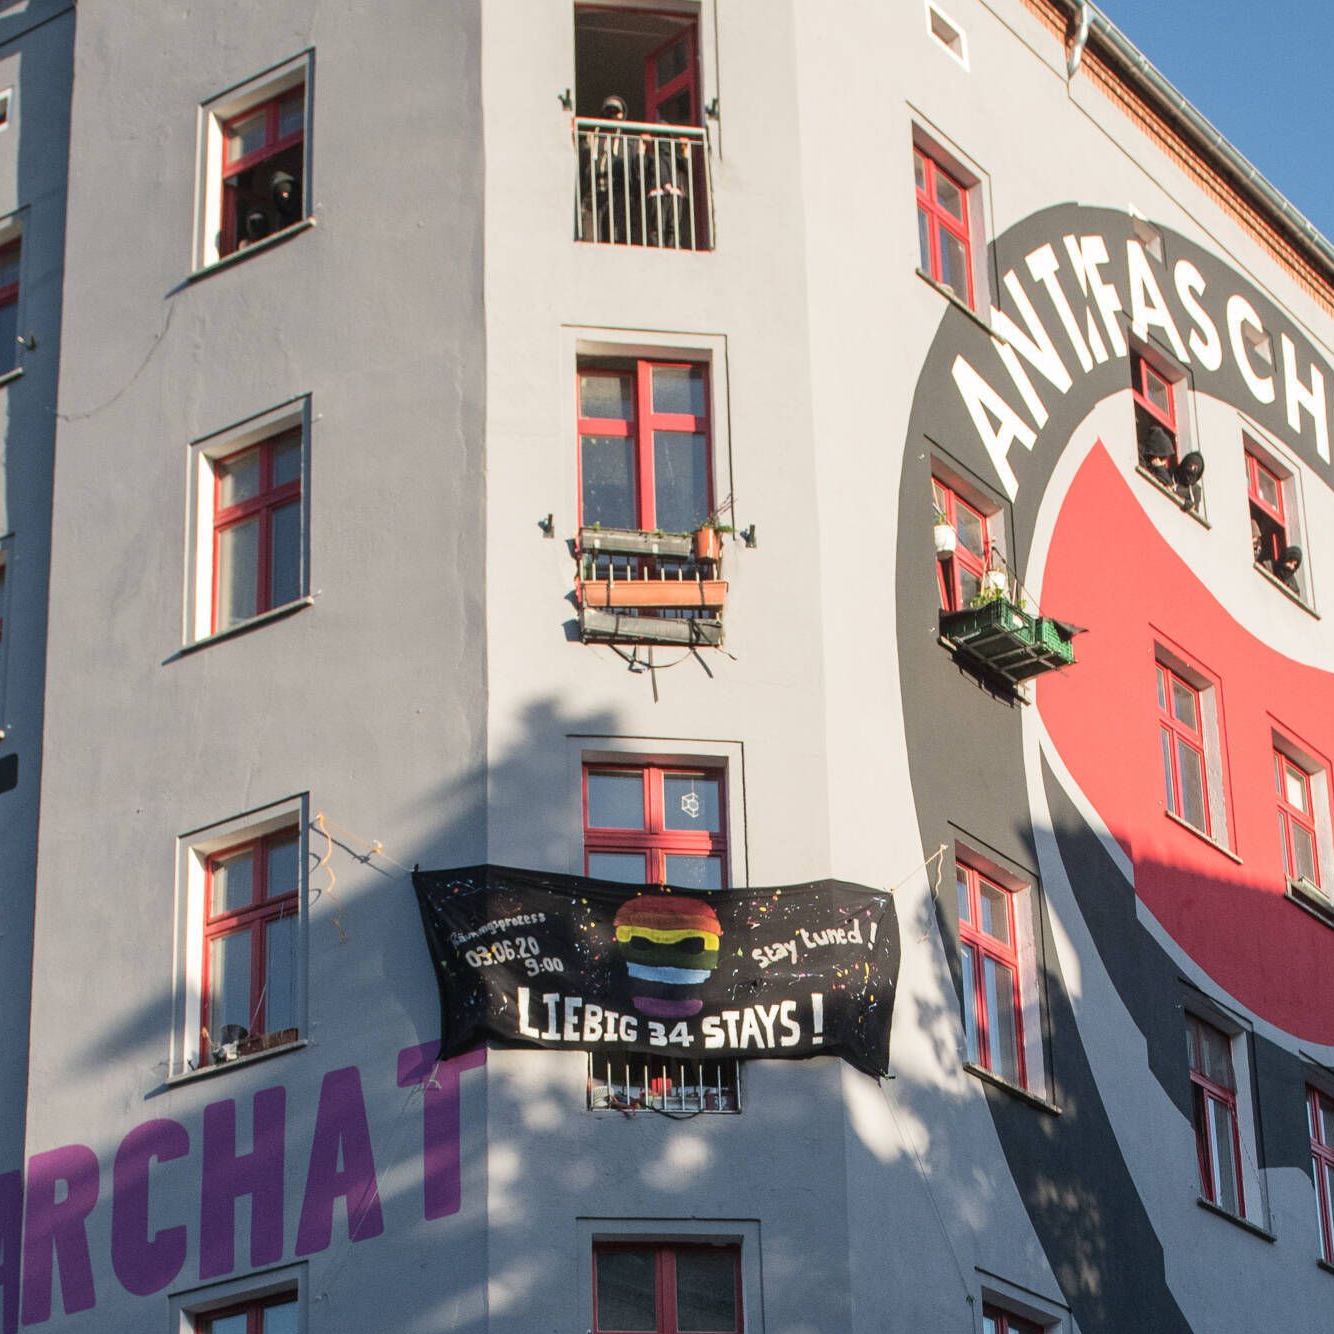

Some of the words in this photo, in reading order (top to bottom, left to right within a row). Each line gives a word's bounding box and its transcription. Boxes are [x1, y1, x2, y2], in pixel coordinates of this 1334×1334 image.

[465, 936, 540, 967] 03.06.20
[524, 957, 564, 977] 9:00
[517, 987, 639, 1042] LIEBIG
[648, 1021, 695, 1047] 34
